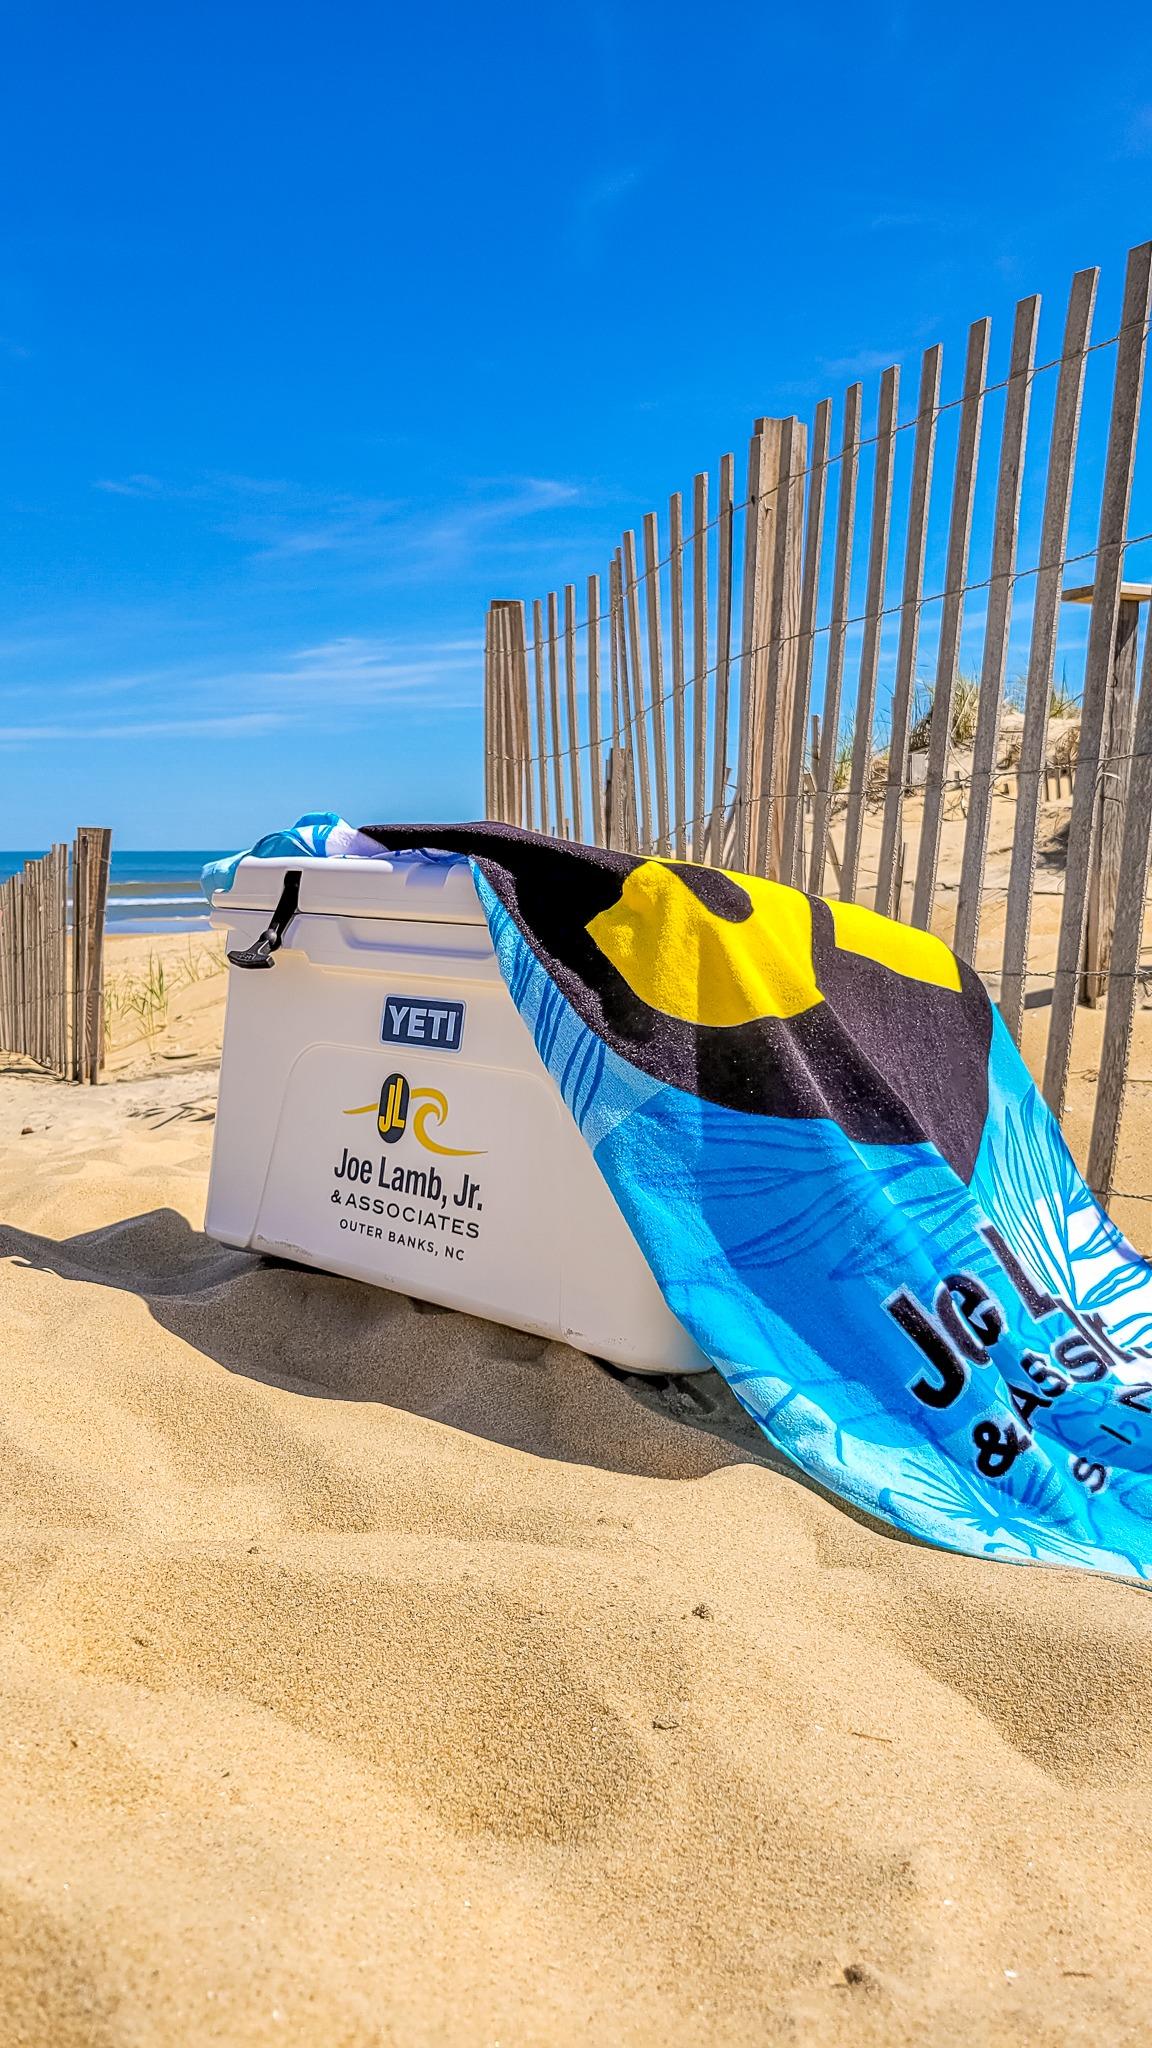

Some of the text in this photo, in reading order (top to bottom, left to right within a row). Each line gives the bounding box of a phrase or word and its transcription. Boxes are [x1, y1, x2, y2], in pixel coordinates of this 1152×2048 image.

[389, 1005, 457, 1041] YETI
[379, 1078, 405, 1133] JL
[334, 1148, 483, 1211] Joe Lamb, Jr.
[330, 1189, 480, 1239] & ASSOCIATES
[339, 1219, 465, 1261] OUTER BANKS, NC
[973, 1420, 1032, 1477] &
